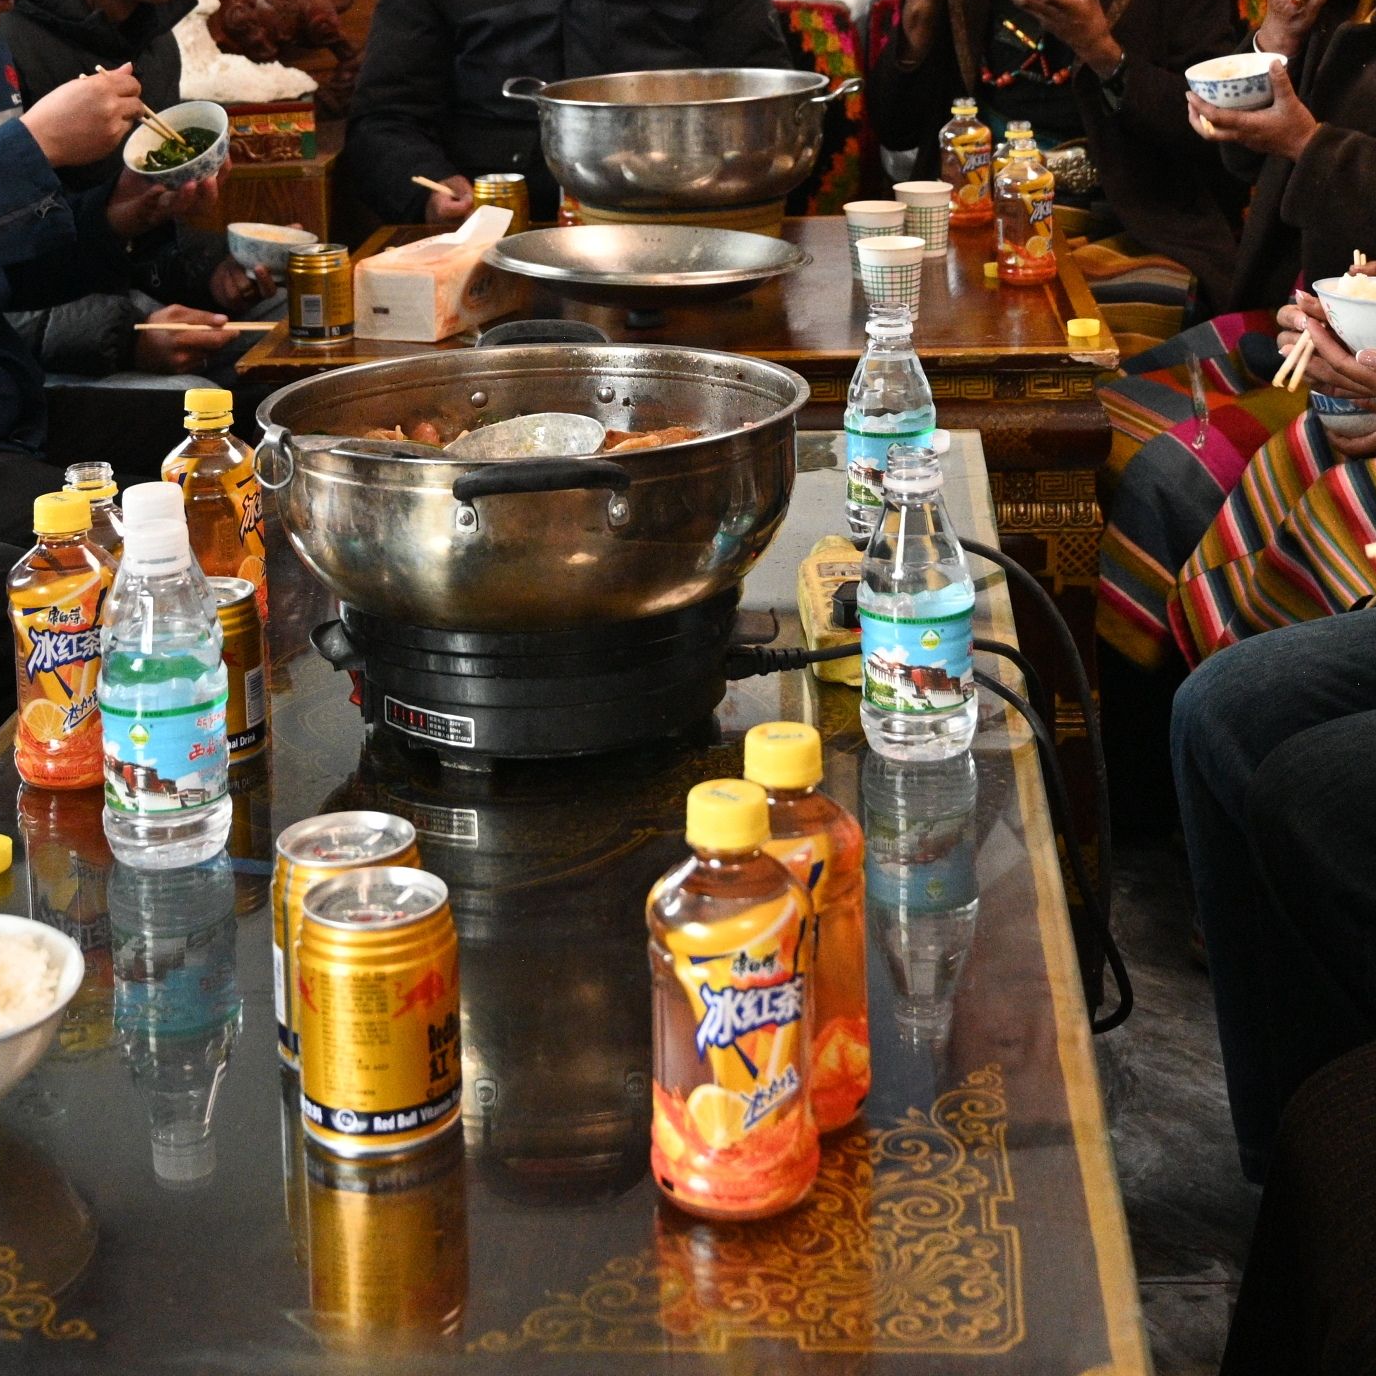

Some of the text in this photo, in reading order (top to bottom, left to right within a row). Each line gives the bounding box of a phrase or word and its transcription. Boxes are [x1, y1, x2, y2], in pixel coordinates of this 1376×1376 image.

[27, 626, 101, 677] 冰红茶
[239, 732, 256, 747] Drink
[697, 974, 802, 1052] 冰红茶
[373, 1115, 395, 1132] Red
[397, 1110, 418, 1129] Bull
